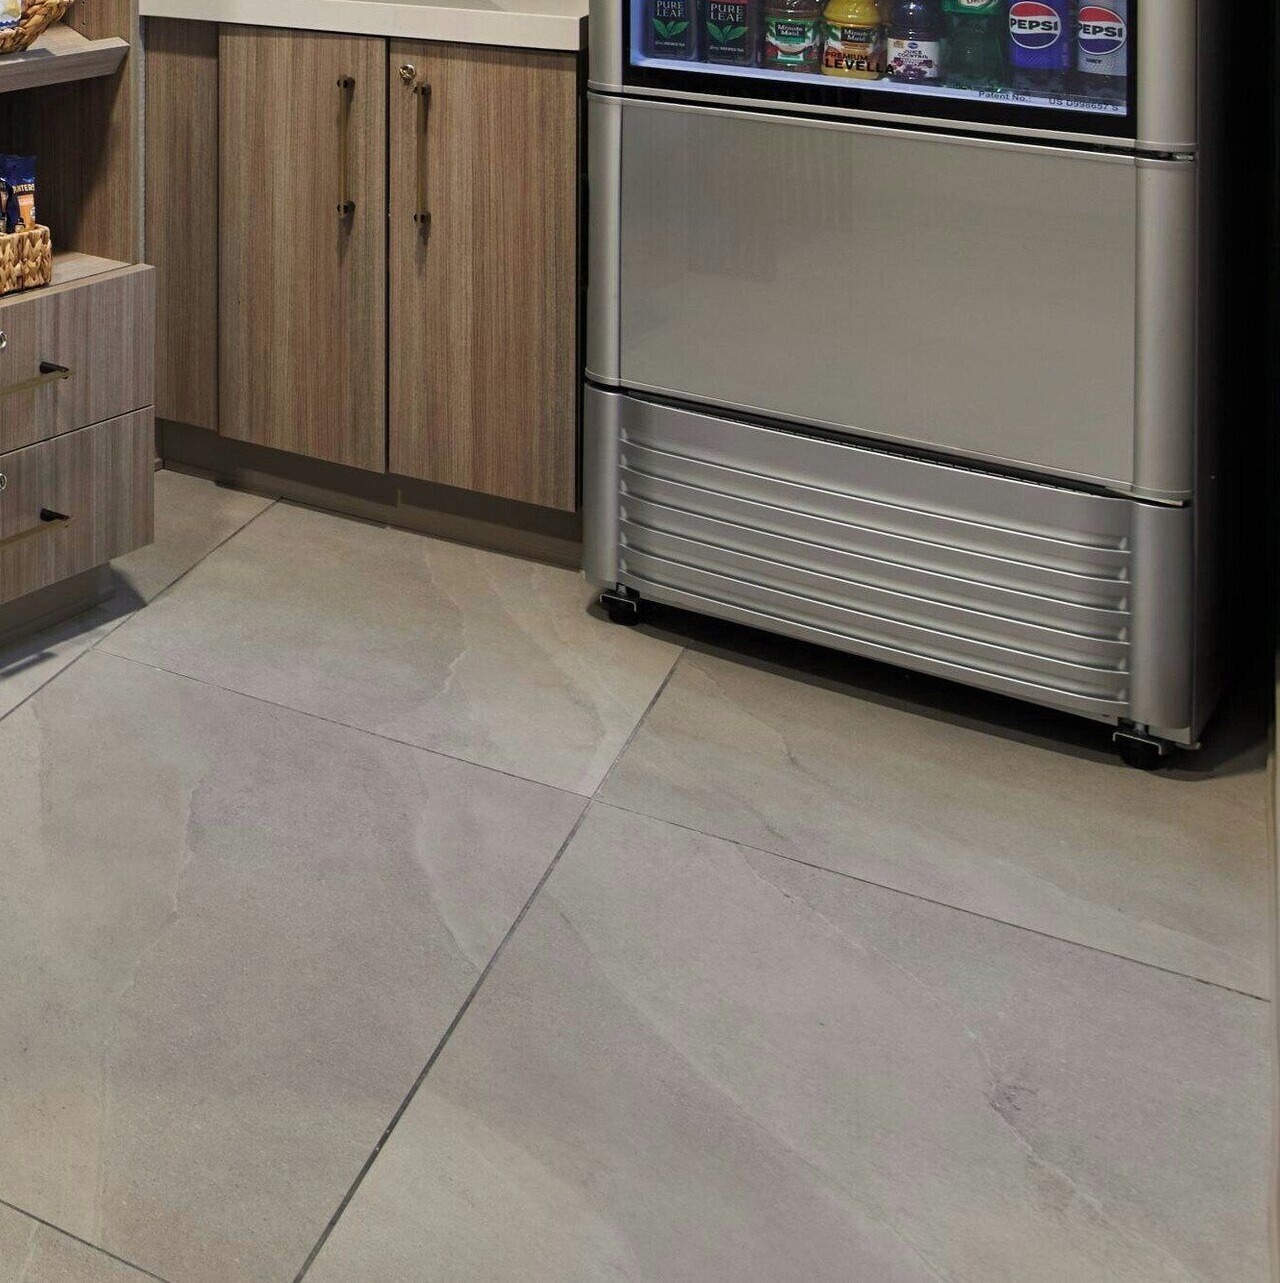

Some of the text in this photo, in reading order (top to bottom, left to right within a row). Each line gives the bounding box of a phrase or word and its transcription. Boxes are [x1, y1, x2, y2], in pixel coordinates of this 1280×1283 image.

[657, 0, 684, 9] PURE
[710, 3, 744, 14] PURE
[657, 9, 684, 17] LEAF
[710, 12, 744, 22] LEAF
[1011, 18, 1058, 31] PEPSI
[1078, 24, 1122, 37] PEPSI
[825, 51, 868, 61] PREMIUM
[825, 58, 895, 74] LEVELLA
[978, 90, 1010, 101] Patent
